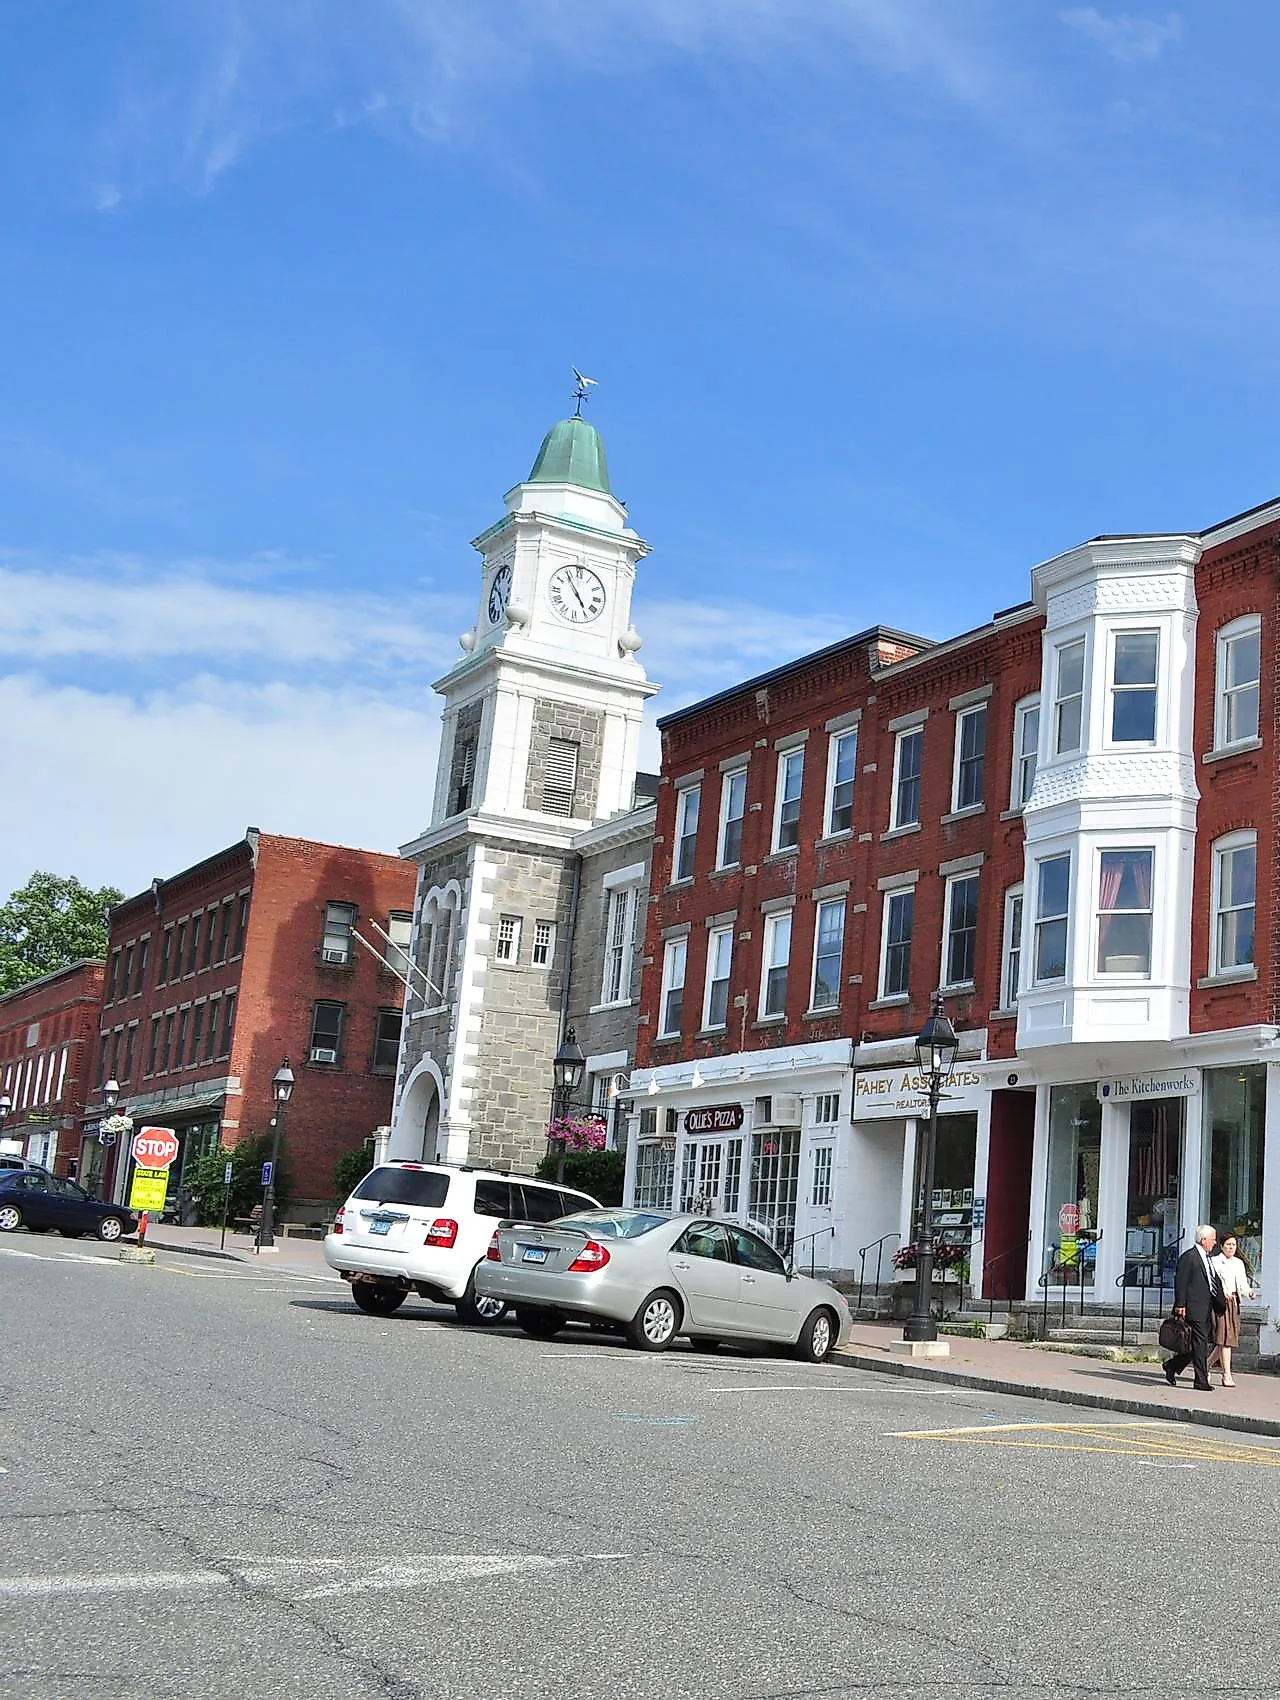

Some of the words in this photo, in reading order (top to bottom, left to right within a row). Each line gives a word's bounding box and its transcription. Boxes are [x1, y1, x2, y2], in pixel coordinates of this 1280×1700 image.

[855, 1078, 894, 1097] FAHEY
[1113, 1080, 1130, 1096] The
[1131, 1074, 1195, 1094] Kitchenworks
[689, 1111, 713, 1131] OLLIE'S
[713, 1110, 737, 1127] PIZZA
[135, 1138, 175, 1157] STOP
